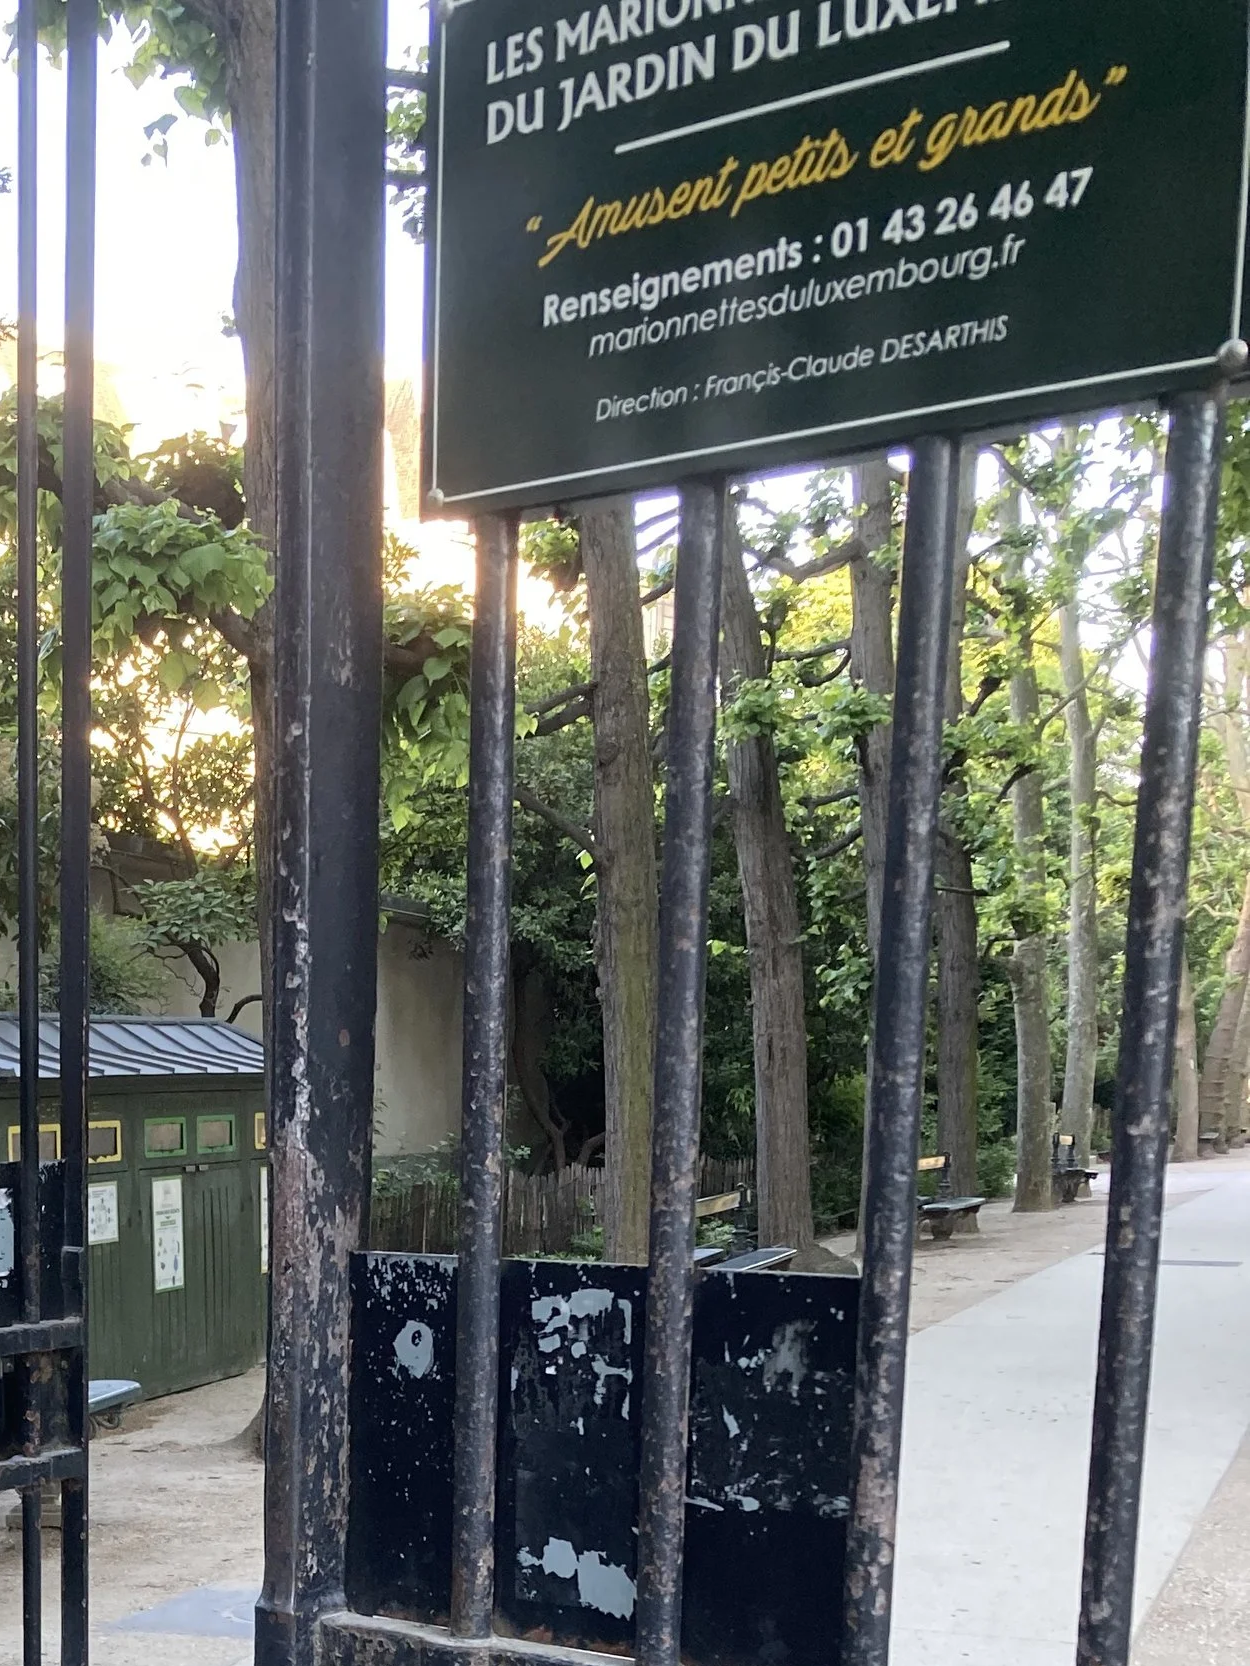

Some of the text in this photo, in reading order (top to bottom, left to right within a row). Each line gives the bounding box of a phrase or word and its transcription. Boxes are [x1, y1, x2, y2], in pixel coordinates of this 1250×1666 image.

[486, 87, 545, 145] DU
[557, 34, 716, 132] JARDIN
[732, 9, 801, 72] DU
[487, 0, 757, 85] LES MARIO
[730, 127, 860, 218] petits
[869, 107, 924, 169] et
[542, 236, 803, 328] Renseignements
[830, 217, 869, 259] 01
[881, 204, 926, 245] 43
[933, 192, 979, 237] 26
[987, 180, 1035, 222] 46
[1044, 166, 1094, 209] 47
[588, 232, 1027, 358] marionnettesduluxembourg.fr
[595, 384, 688, 422] Direction
[879, 314, 1009, 364] DESARTHIS
